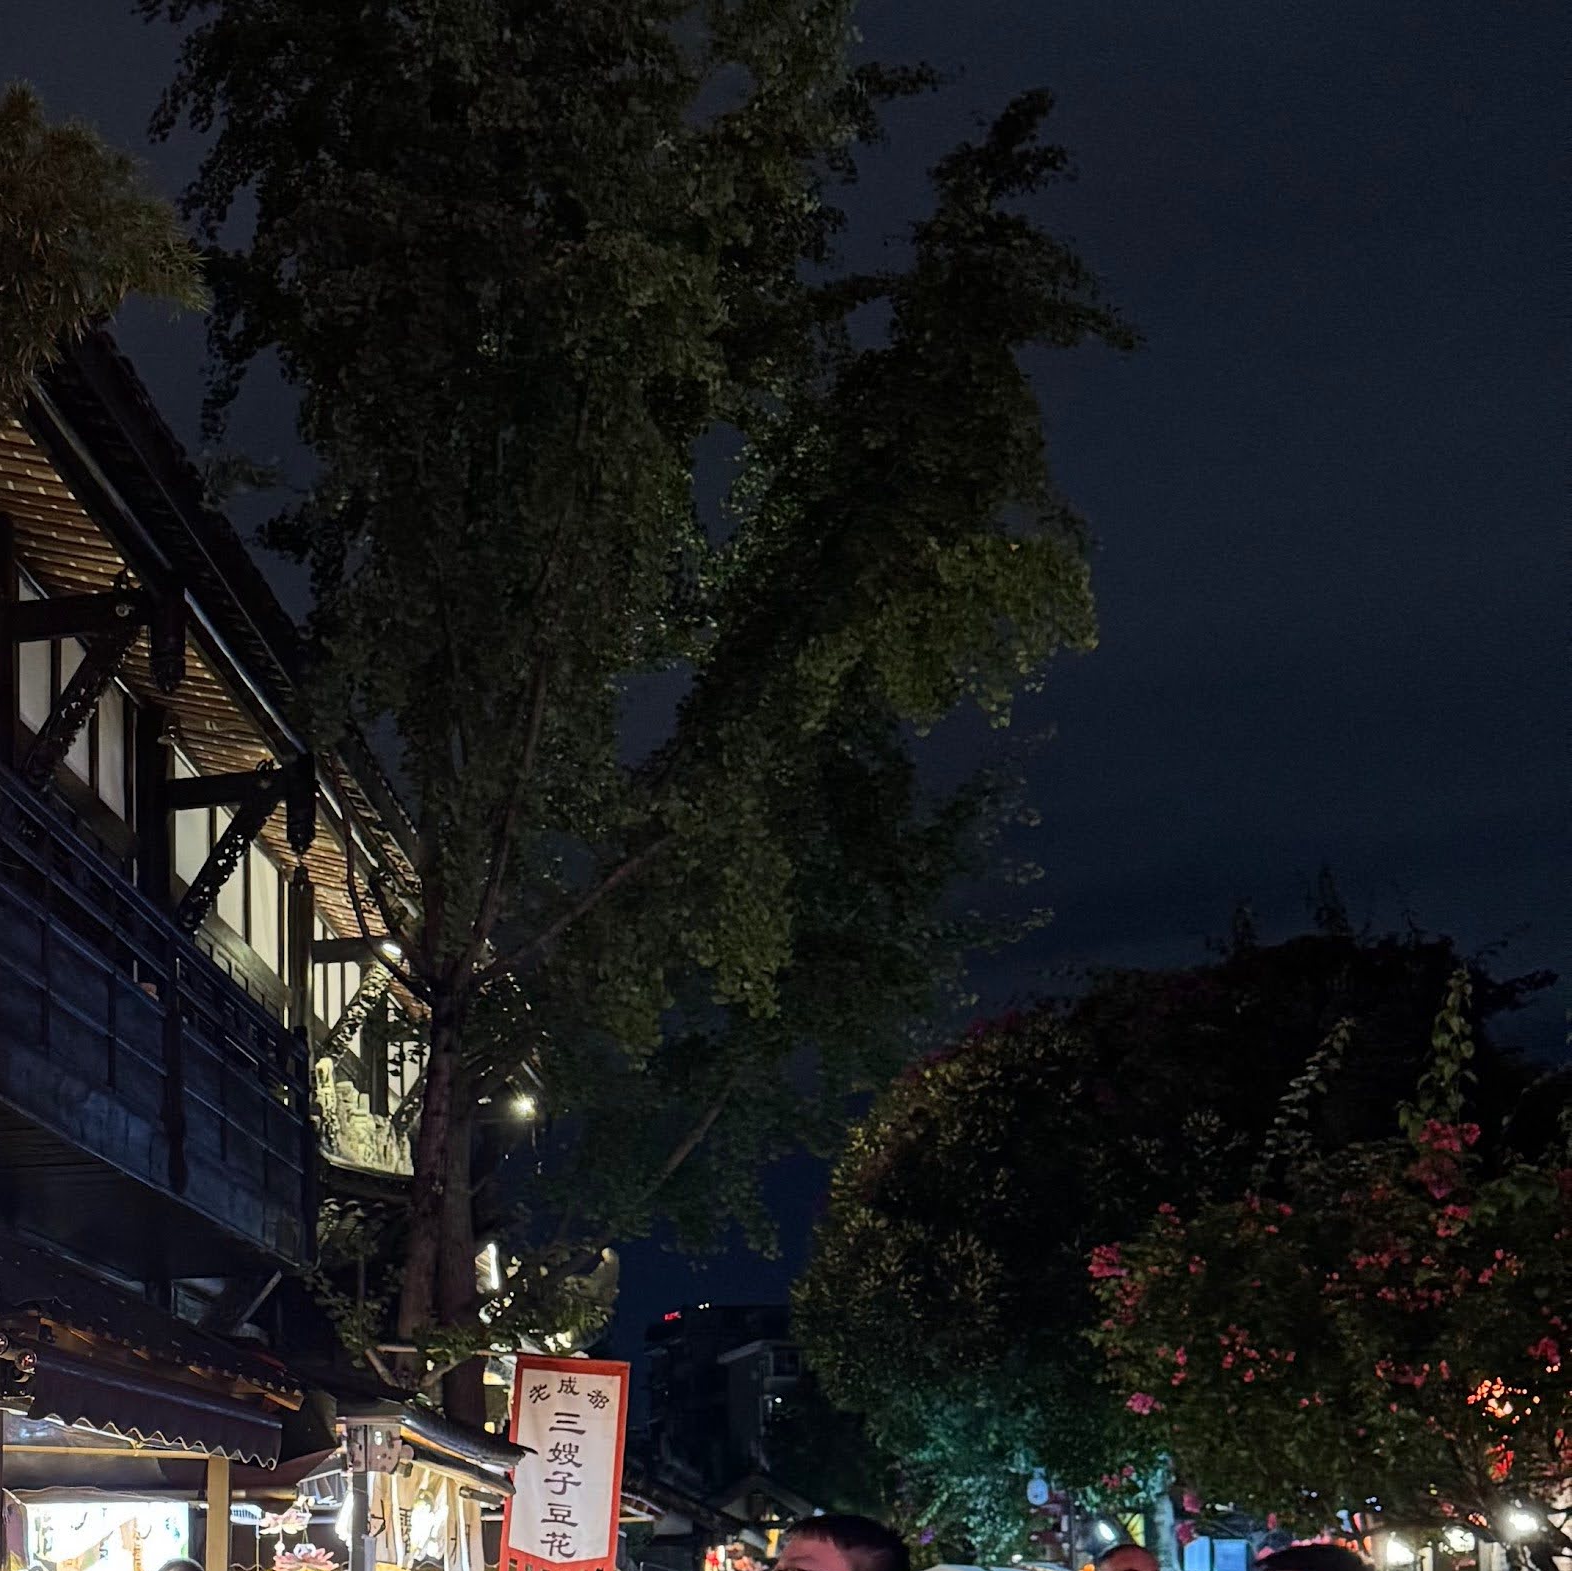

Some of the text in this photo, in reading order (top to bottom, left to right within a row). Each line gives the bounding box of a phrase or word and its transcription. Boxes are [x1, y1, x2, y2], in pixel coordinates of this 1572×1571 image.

[529, 1376, 610, 1410] 老成都
[540, 1412, 586, 1558] 三嫂子豆花
